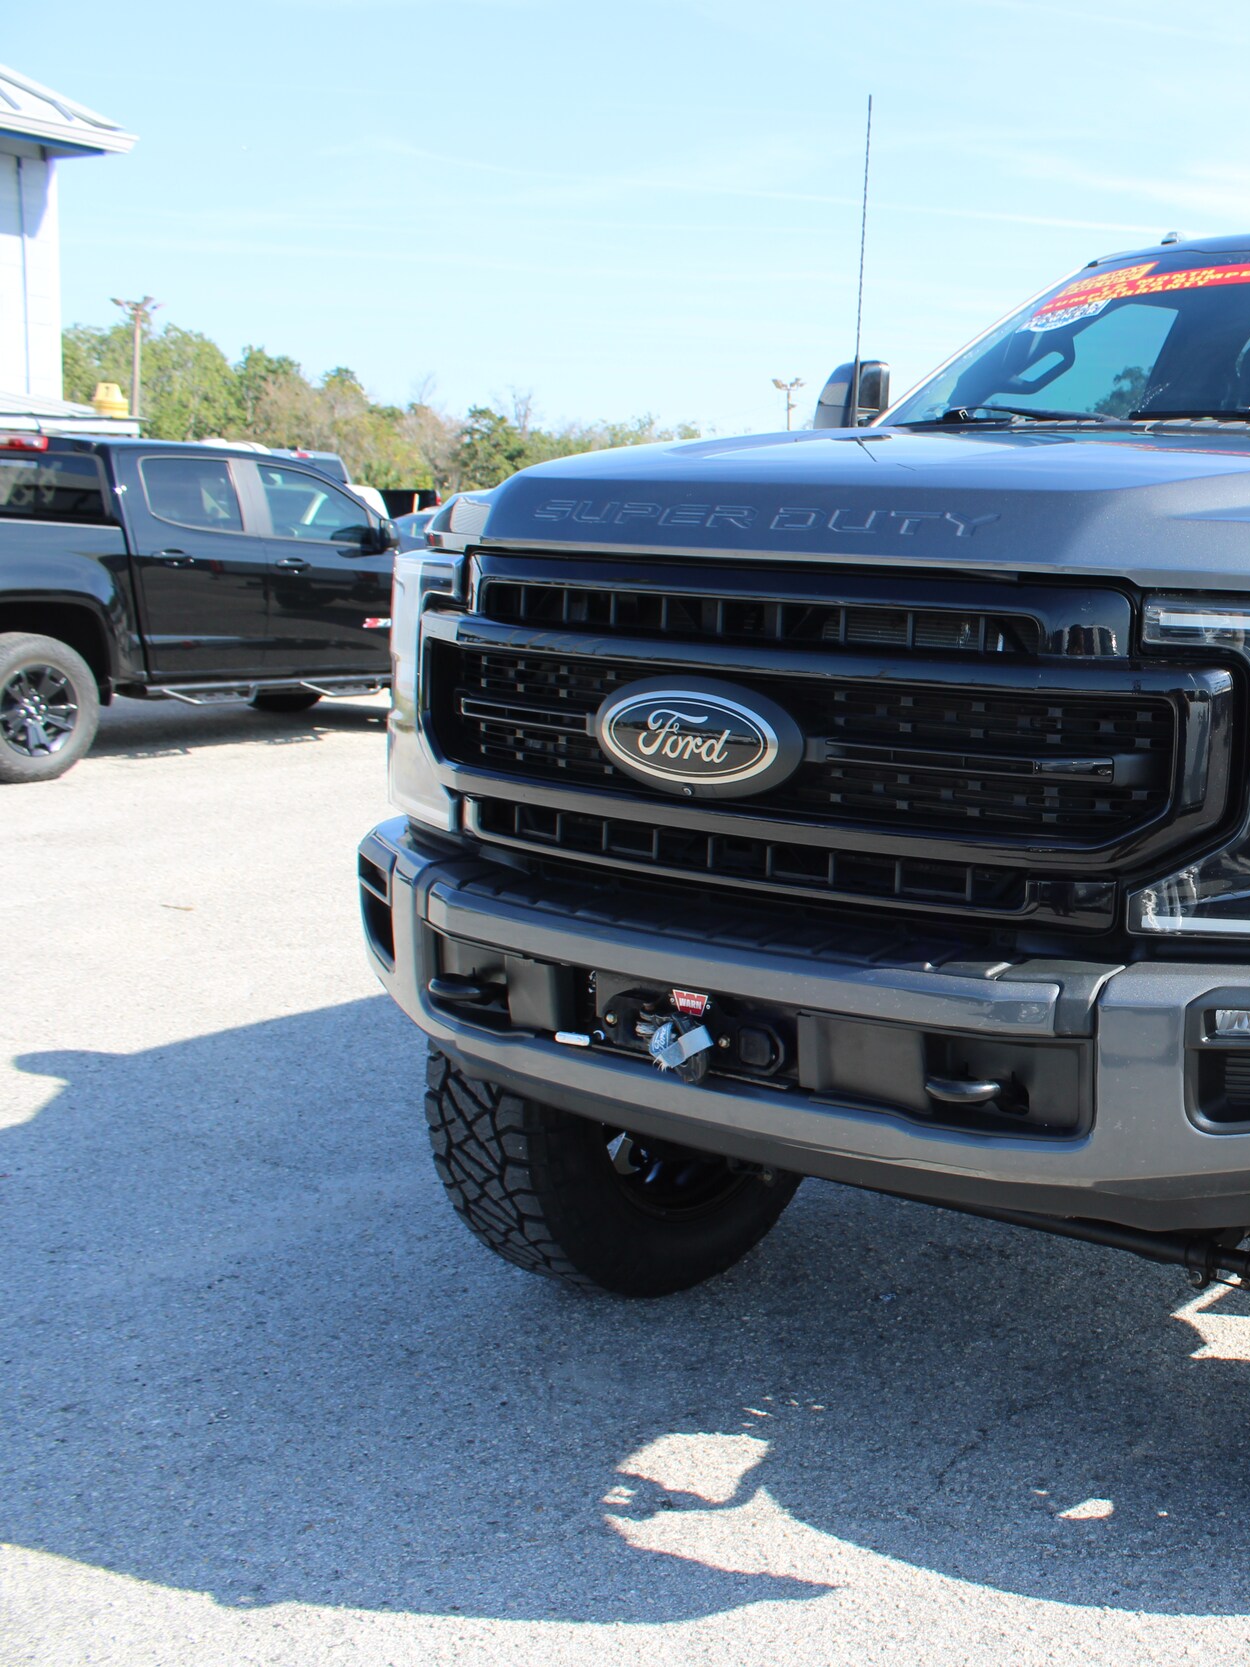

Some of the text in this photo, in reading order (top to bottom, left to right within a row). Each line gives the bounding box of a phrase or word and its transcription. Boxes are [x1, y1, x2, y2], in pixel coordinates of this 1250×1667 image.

[1136, 269, 1216, 286] MONTH
[533, 499, 1001, 538] SUPER DUTY
[637, 708, 732, 764] Ford
[678, 997, 702, 1010] WARN
